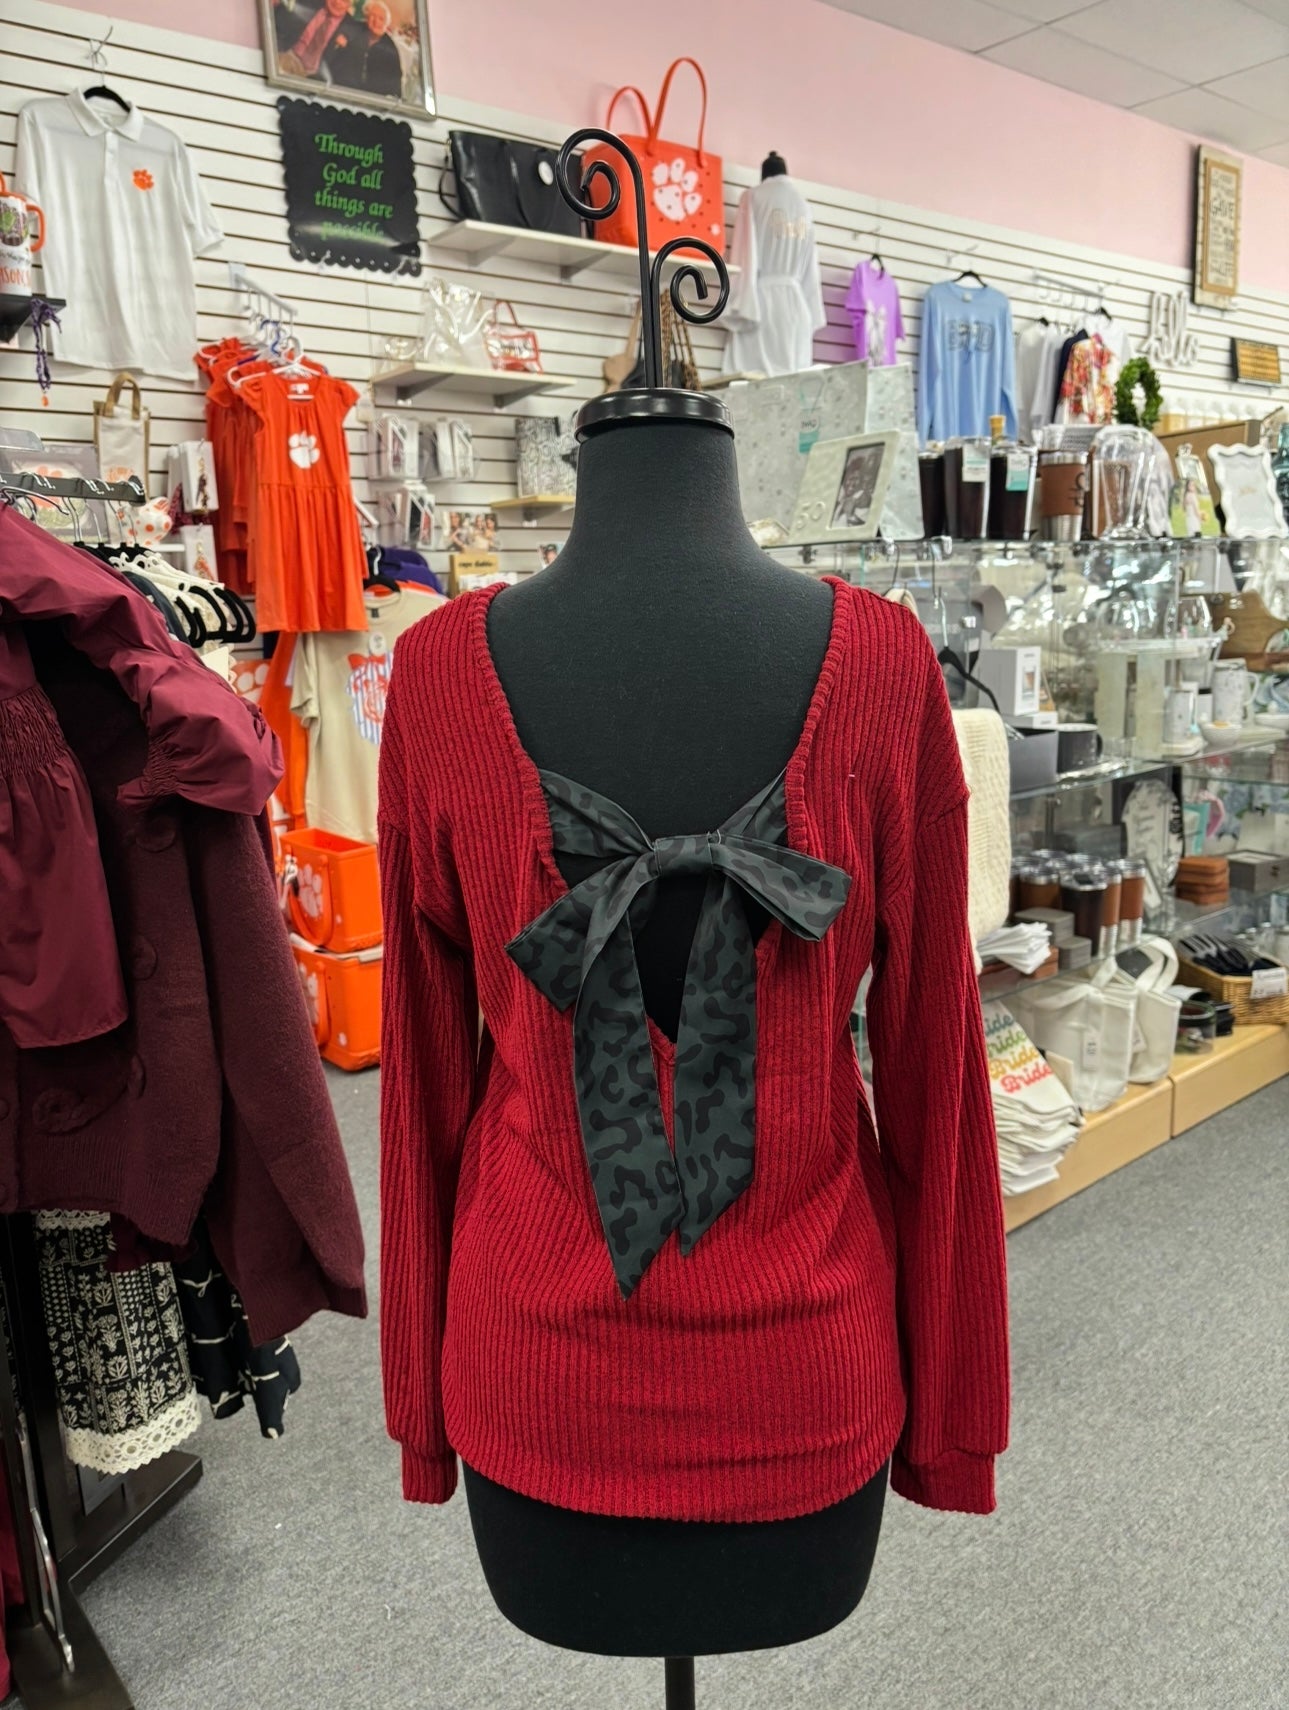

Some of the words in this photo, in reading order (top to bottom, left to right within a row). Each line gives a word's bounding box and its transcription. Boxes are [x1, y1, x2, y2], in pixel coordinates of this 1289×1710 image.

[314, 133, 384, 167] Through
[323, 163, 359, 186] God
[360, 169, 384, 190] all
[314, 187, 365, 218] things
[368, 202, 394, 219] are
[985, 1012, 1014, 1036] ide
[987, 1029, 1027, 1058] ride
[988, 1045, 1040, 1080] Bride
[1000, 1062, 1053, 1094] Bride
